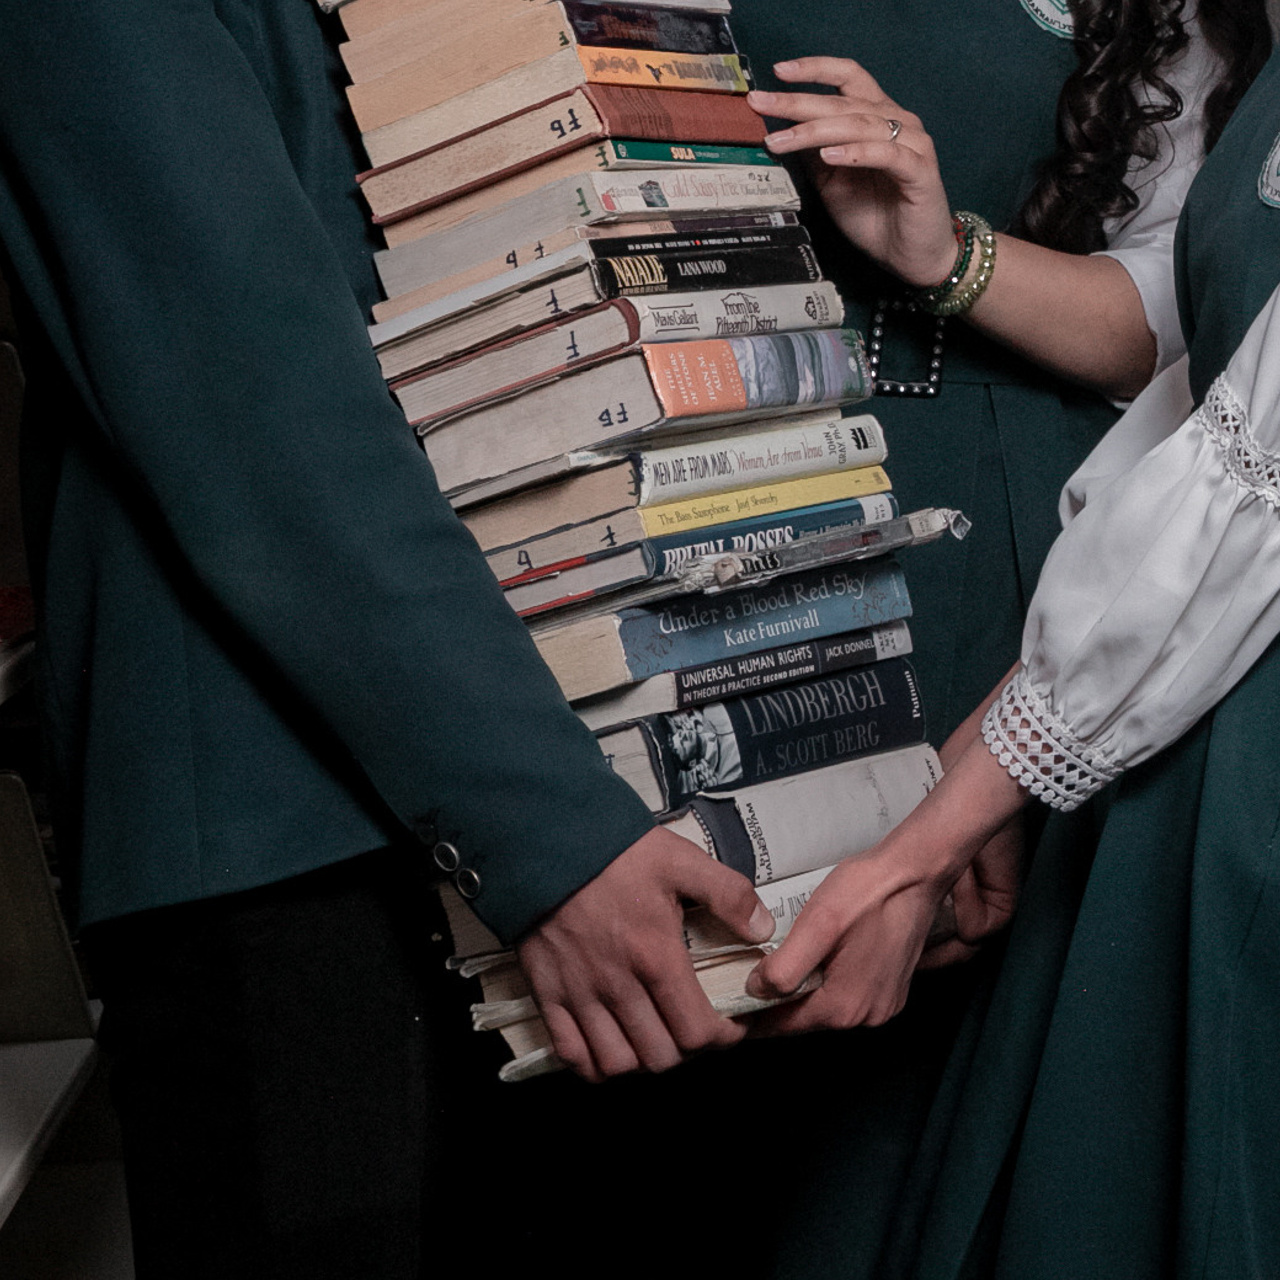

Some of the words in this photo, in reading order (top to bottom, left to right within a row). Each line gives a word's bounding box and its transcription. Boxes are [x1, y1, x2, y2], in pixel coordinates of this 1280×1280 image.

[670, 146, 697, 161] SULA
[662, 172, 690, 199] Cold
[607, 255, 669, 288] NATALIE
[677, 261, 699, 276] LANA
[698, 259, 727, 275] WOOD
[668, 351, 690, 406] SHELTERS
[677, 351, 693, 388] STONE
[702, 370, 718, 402] JEAN
[709, 359, 723, 393] AUEL
[824, 431, 837, 455] JOHN
[836, 442, 847, 465] GRAY
[652, 461, 671, 488] MEN
[671, 460, 688, 484] ARE
[688, 456, 711, 481] FROM
[658, 513, 675, 526] The
[676, 509, 692, 523] Bass
[658, 608, 719, 635] Under
[725, 608, 736, 621] a
[739, 586, 790, 617] Blood
[795, 581, 832, 605] Red
[832, 573, 868, 601] Sky
[723, 625, 757, 648] Kate
[759, 609, 821, 640] Furnivall
[681, 663, 736, 689] UNIVERSAL
[737, 652, 776, 675] HUMAN
[778, 645, 813, 665] RIGHTS
[825, 645, 845, 662] JACK
[844, 638, 876, 654] DONNEL
[683, 690, 693, 702] IN
[693, 683, 721, 701] THEORY
[721, 683, 728, 695] &
[728, 676, 762, 694] PRACTICE
[762, 670, 788, 685] SECOND
[788, 664, 815, 681] EDITION
[904, 669, 922, 719] Putnam
[741, 670, 887, 737] LINDBERGH
[755, 752, 773, 777] A.
[776, 732, 829, 769] SCOTT
[832, 720, 881, 755] BERG
